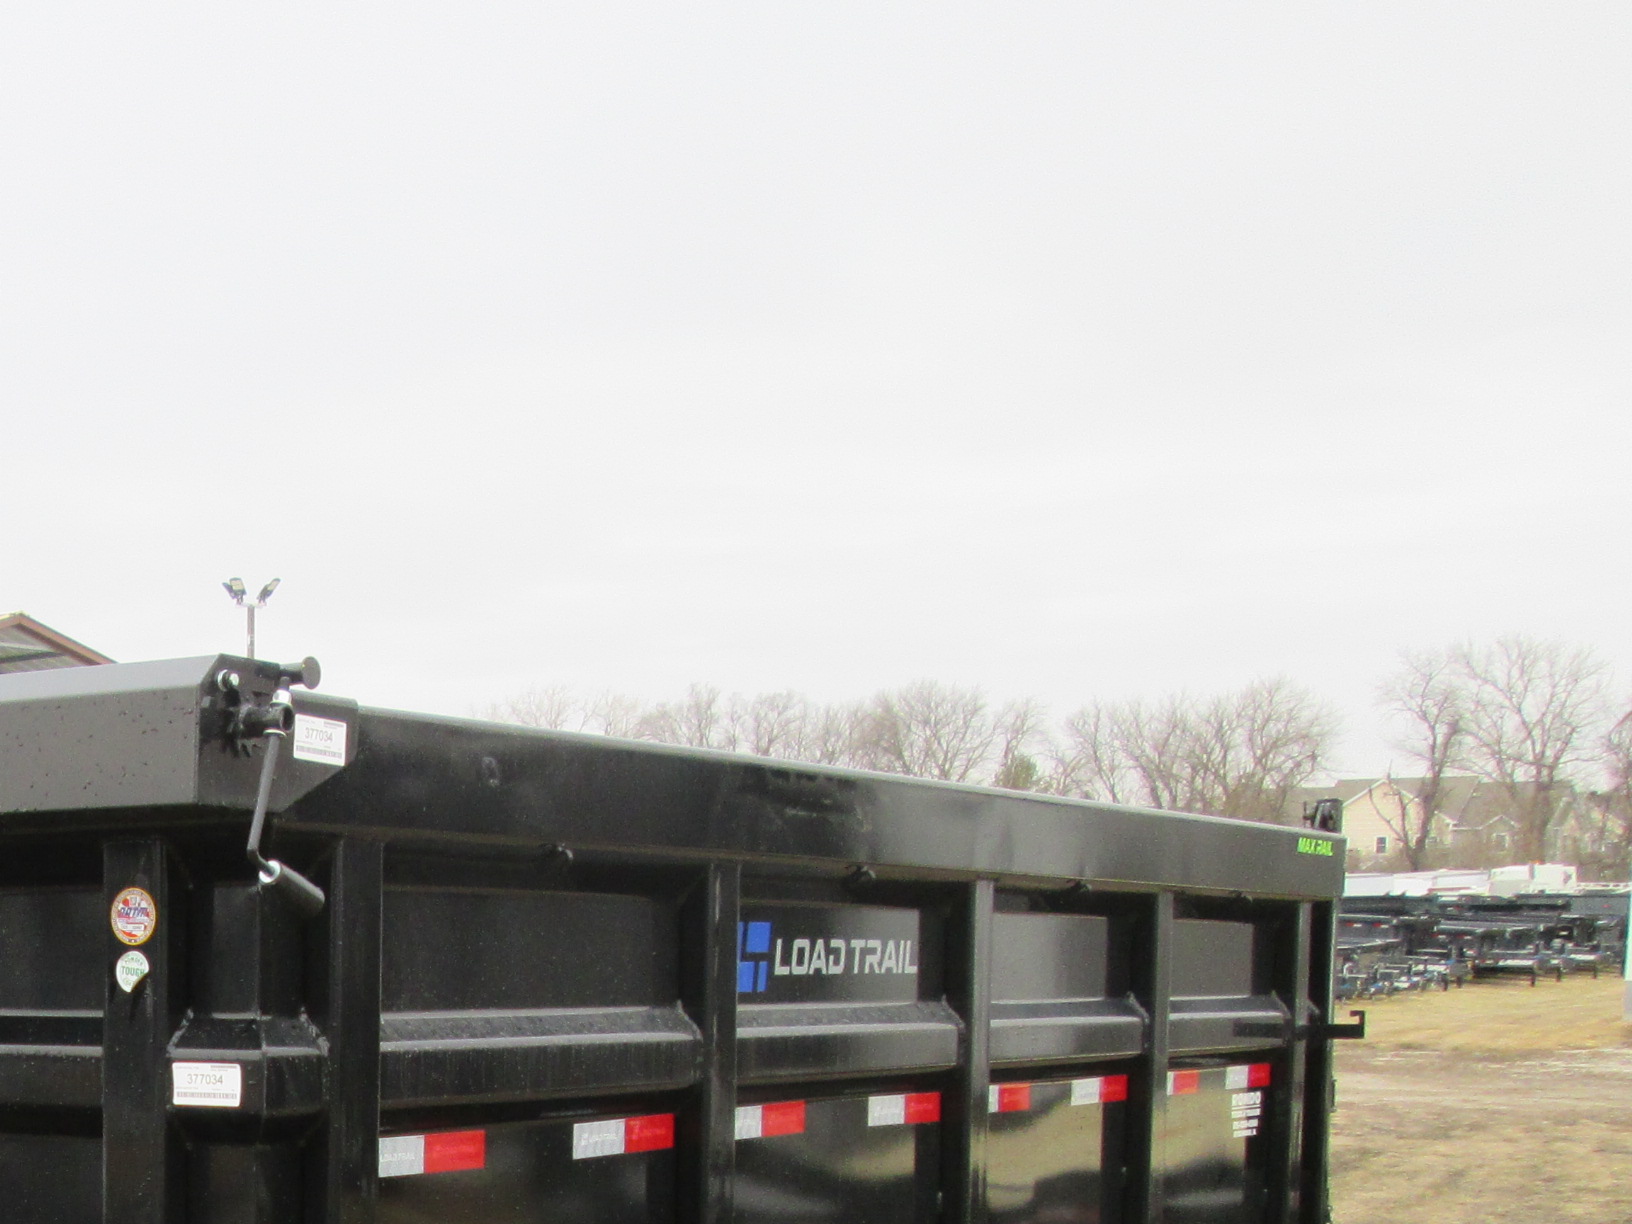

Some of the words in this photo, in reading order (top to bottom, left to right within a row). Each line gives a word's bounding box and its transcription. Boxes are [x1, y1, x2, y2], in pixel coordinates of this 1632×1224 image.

[304, 727, 334, 743] 377034
[774, 938, 846, 976] LOAD
[850, 939, 918, 974] TRAIL
[186, 1073, 223, 1085] 377034
